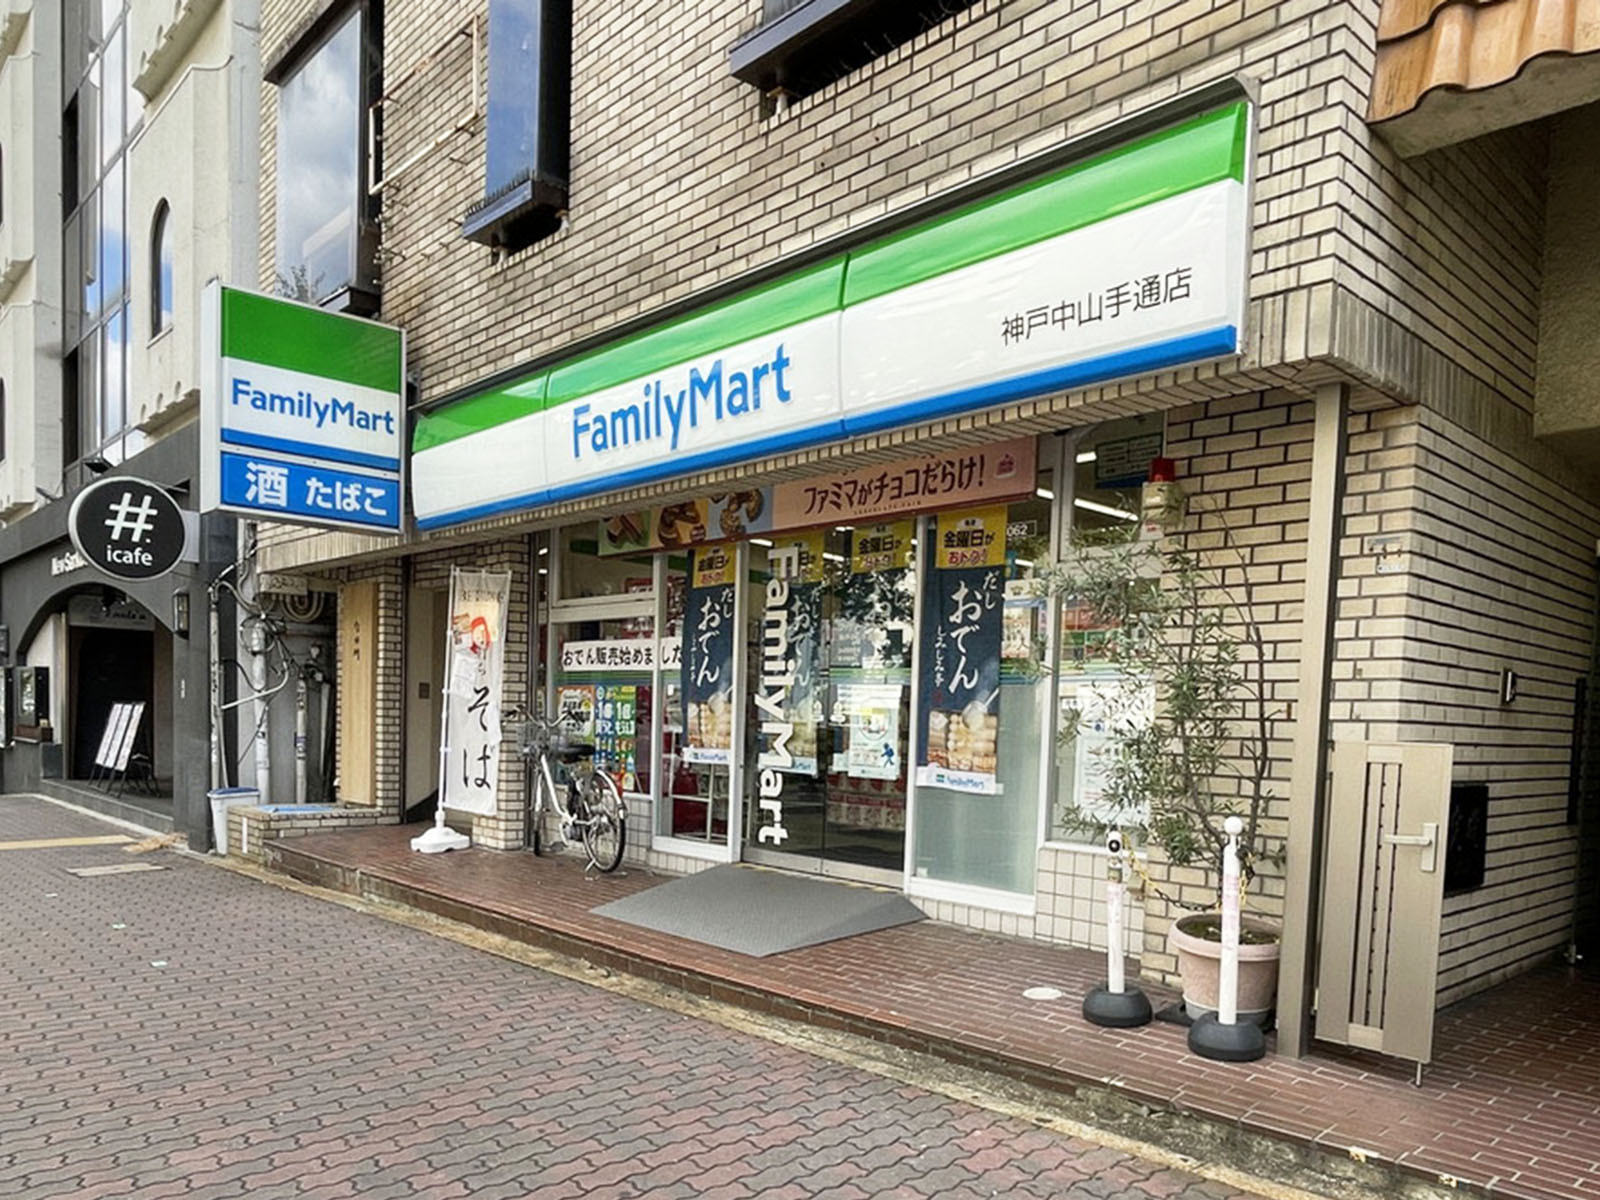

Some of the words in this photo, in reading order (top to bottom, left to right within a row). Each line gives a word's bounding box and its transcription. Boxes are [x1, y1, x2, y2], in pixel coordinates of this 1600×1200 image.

[1001, 267, 1193, 347] 神戸中山手通店
[231, 377, 395, 435] FamilyMart
[573, 343, 791, 459] FamilyMart
[245, 461, 289, 508] 酒
[305, 476, 388, 517] たばこ
[106, 544, 154, 566] icafe
[983, 570, 1000, 610] だし
[697, 596, 721, 688] おでん
[948, 580, 982, 694] おでん
[463, 685, 493, 791] そば
[754, 546, 799, 846] FamilyMart
